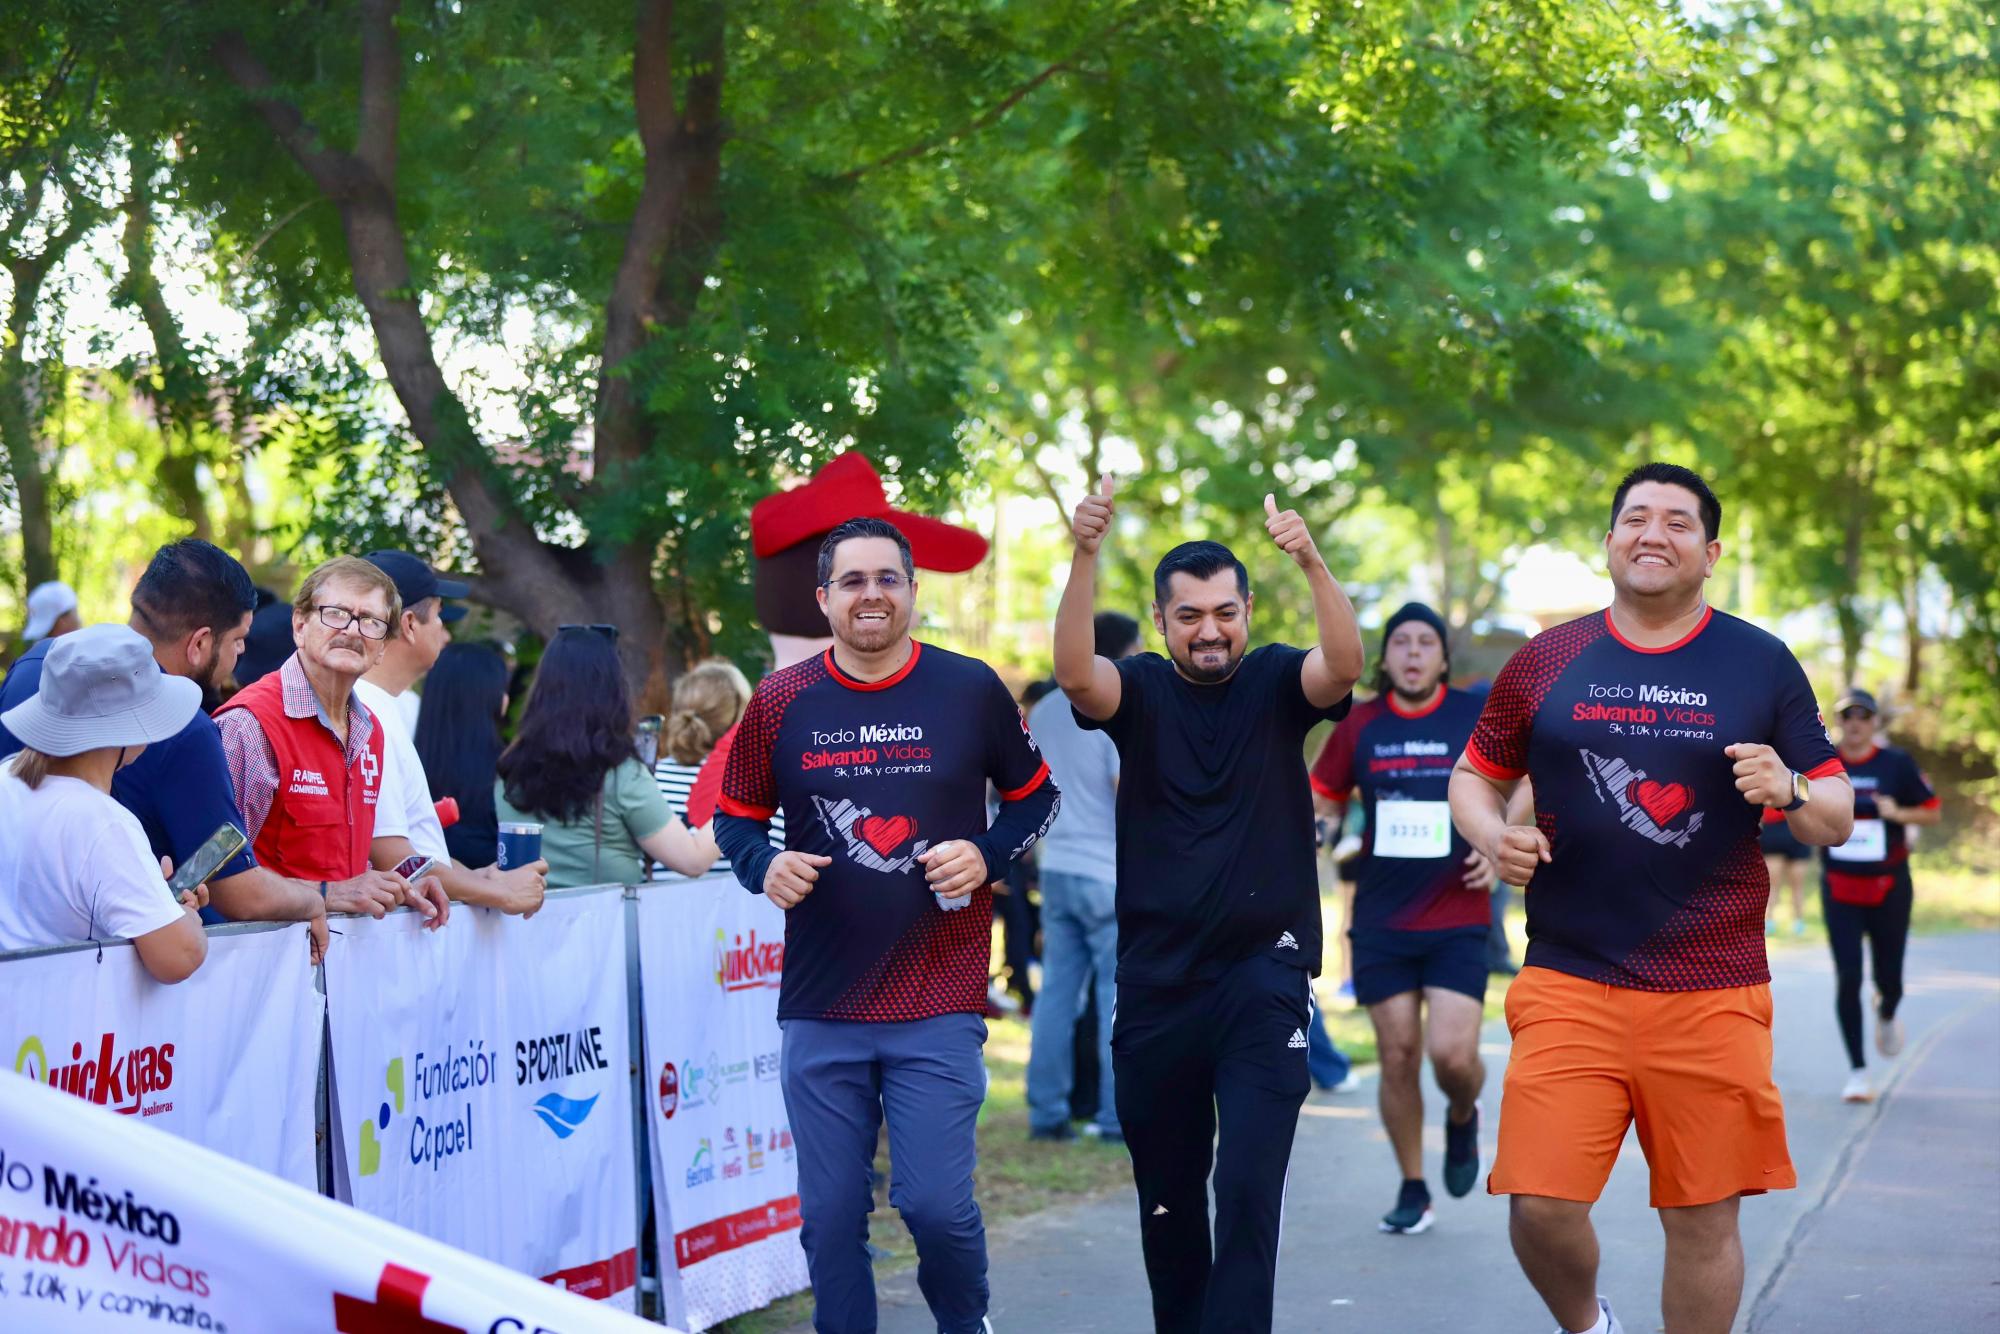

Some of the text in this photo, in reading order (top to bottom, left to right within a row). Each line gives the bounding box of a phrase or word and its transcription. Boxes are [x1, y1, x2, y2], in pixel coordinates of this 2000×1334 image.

[1588, 684, 1708, 707] Todo México
[1572, 702, 1716, 726] Salvando Vidas
[811, 723, 923, 746] Todo México
[1609, 723, 1714, 740] 5k, 10k y caminata
[801, 744, 932, 771] Salvando Vidas
[834, 763, 931, 778] 5k, 10k y caminata
[515, 1026, 608, 1086] SPORTLINE
[43, 1164, 181, 1246] México
[102, 1232, 211, 1298] Vidas
[20, 1270, 66, 1303] 10k
[77, 1287, 93, 1311] y
